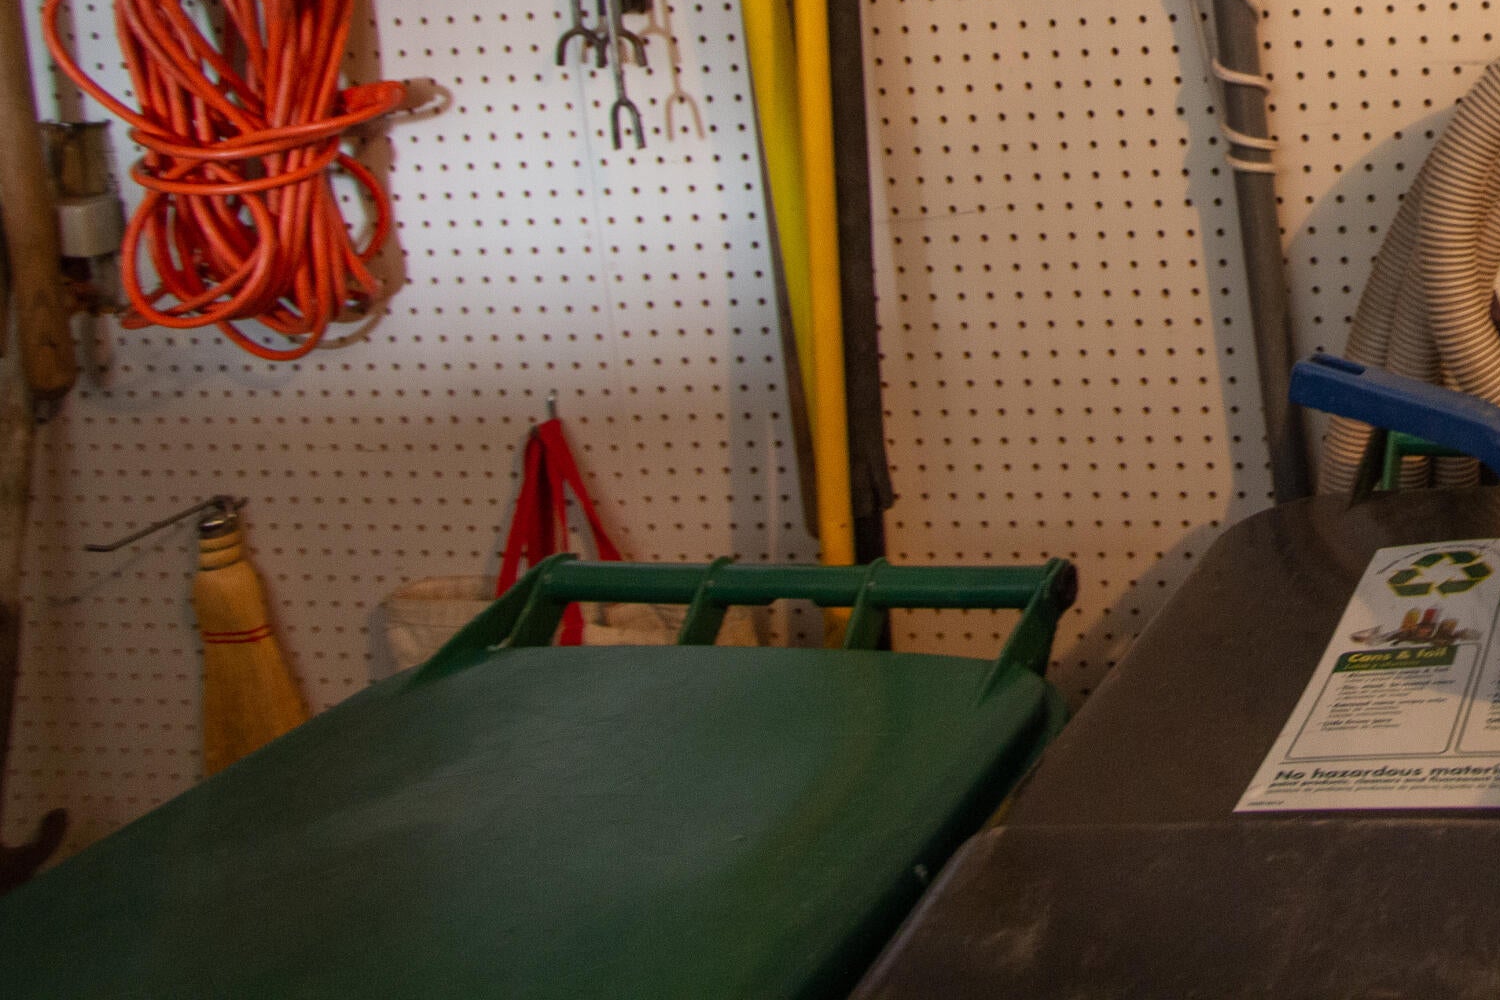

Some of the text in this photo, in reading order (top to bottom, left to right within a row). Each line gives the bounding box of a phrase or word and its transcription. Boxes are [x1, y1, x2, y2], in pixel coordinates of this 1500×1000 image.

[1348, 646, 1448, 663] Cans & foil
[1274, 769, 1304, 781] No
[1311, 765, 1423, 780] hazardous
